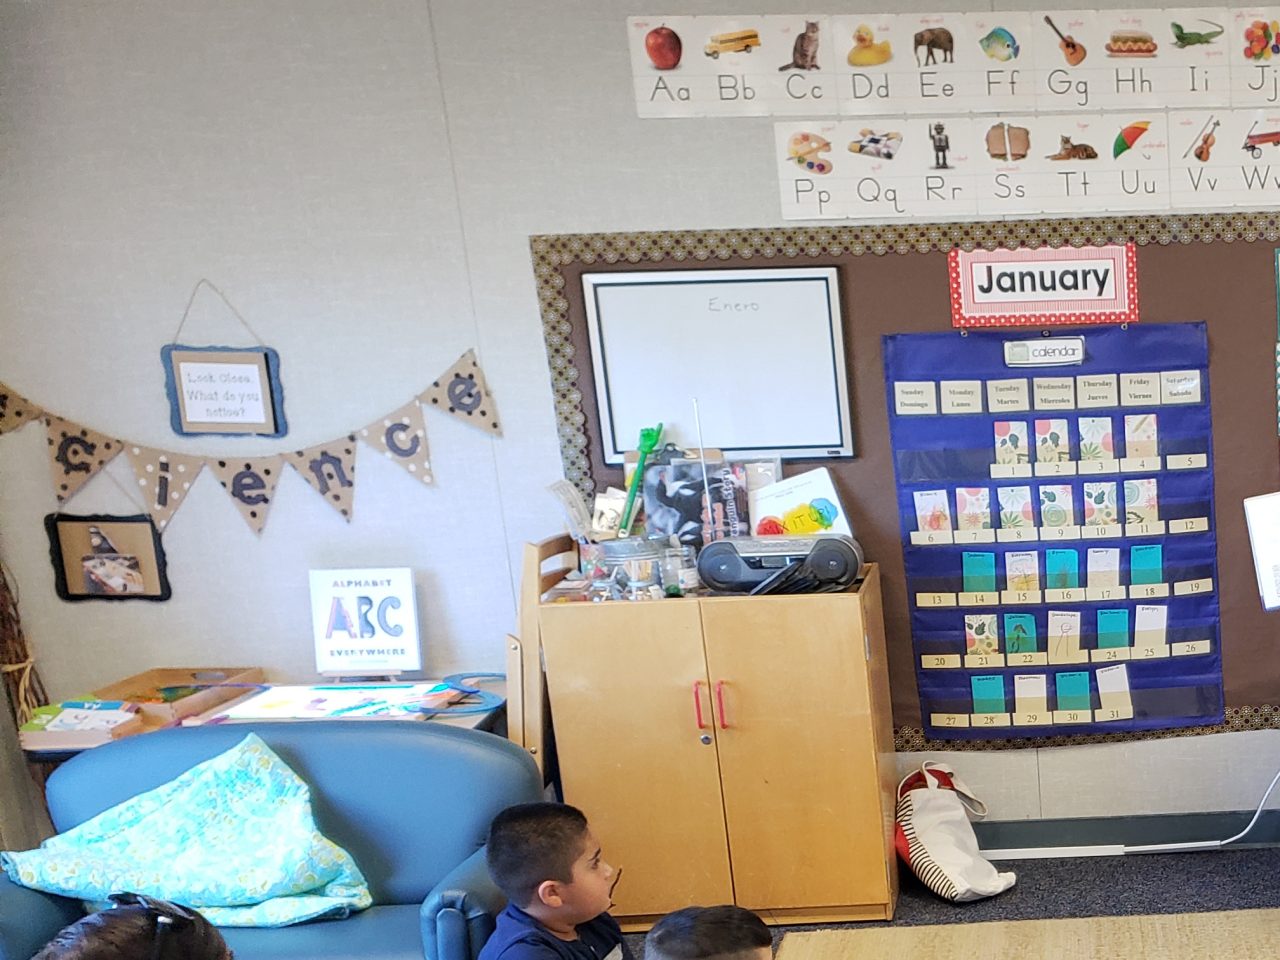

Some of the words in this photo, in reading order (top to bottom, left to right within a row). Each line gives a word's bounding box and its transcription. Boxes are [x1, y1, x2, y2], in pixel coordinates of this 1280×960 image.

[650, 76, 691, 101] Aa
[718, 75, 755, 101] Bb
[786, 74, 823, 100] Cc
[852, 73, 889, 99] Dd
[921, 72, 954, 98] Ee
[987, 70, 1020, 96] Ff
[1048, 70, 1089, 105] Gg
[1115, 67, 1152, 93] Hh
[1189, 67, 1208, 92] Ii
[1248, 65, 1278, 102] Jj
[795, 179, 830, 214] Pp
[857, 177, 904, 213] Qq
[927, 176, 962, 201] Rr
[994, 174, 1025, 199] Ss
[1058, 172, 1090, 198] Tt
[1122, 170, 1156, 196] Uu
[1187, 168, 1217, 192] Vv
[977, 265, 1110, 297] January
[708, 297, 761, 313] Enero
[1031, 345, 1080, 358] calendar
[1083, 380, 1113, 389] Thursday
[1129, 378, 1150, 387] Friday
[949, 389, 974, 397] Monday
[722, 467, 734, 498] Story
[727, 499, 739, 538] enguin
[791, 514, 805, 530] IT
[1140, 524, 1149, 533] 11
[1185, 521, 1194, 530] 12
[1096, 527, 1106, 536] 10
[332, 579, 392, 588] ALPHABET
[1190, 582, 1200, 592] 19
[1061, 591, 1072, 600] 16
[1101, 590, 1111, 599] 17
[1145, 587, 1155, 596] 18
[932, 595, 942, 604] 13
[975, 594, 985, 603] 14
[1017, 592, 1027, 601] 15
[325, 595, 404, 639] ABC
[1145, 648, 1155, 657] 25
[1185, 643, 1196, 653] 26
[1023, 654, 1033, 663] 22
[1106, 650, 1117, 660] 24
[935, 657, 946, 666] 20
[978, 657, 989, 666] 21
[1027, 714, 1037, 723] 29
[1067, 712, 1078, 722] 30
[1110, 710, 1119, 719] 31
[946, 716, 957, 726] 27
[983, 715, 995, 725] 28
